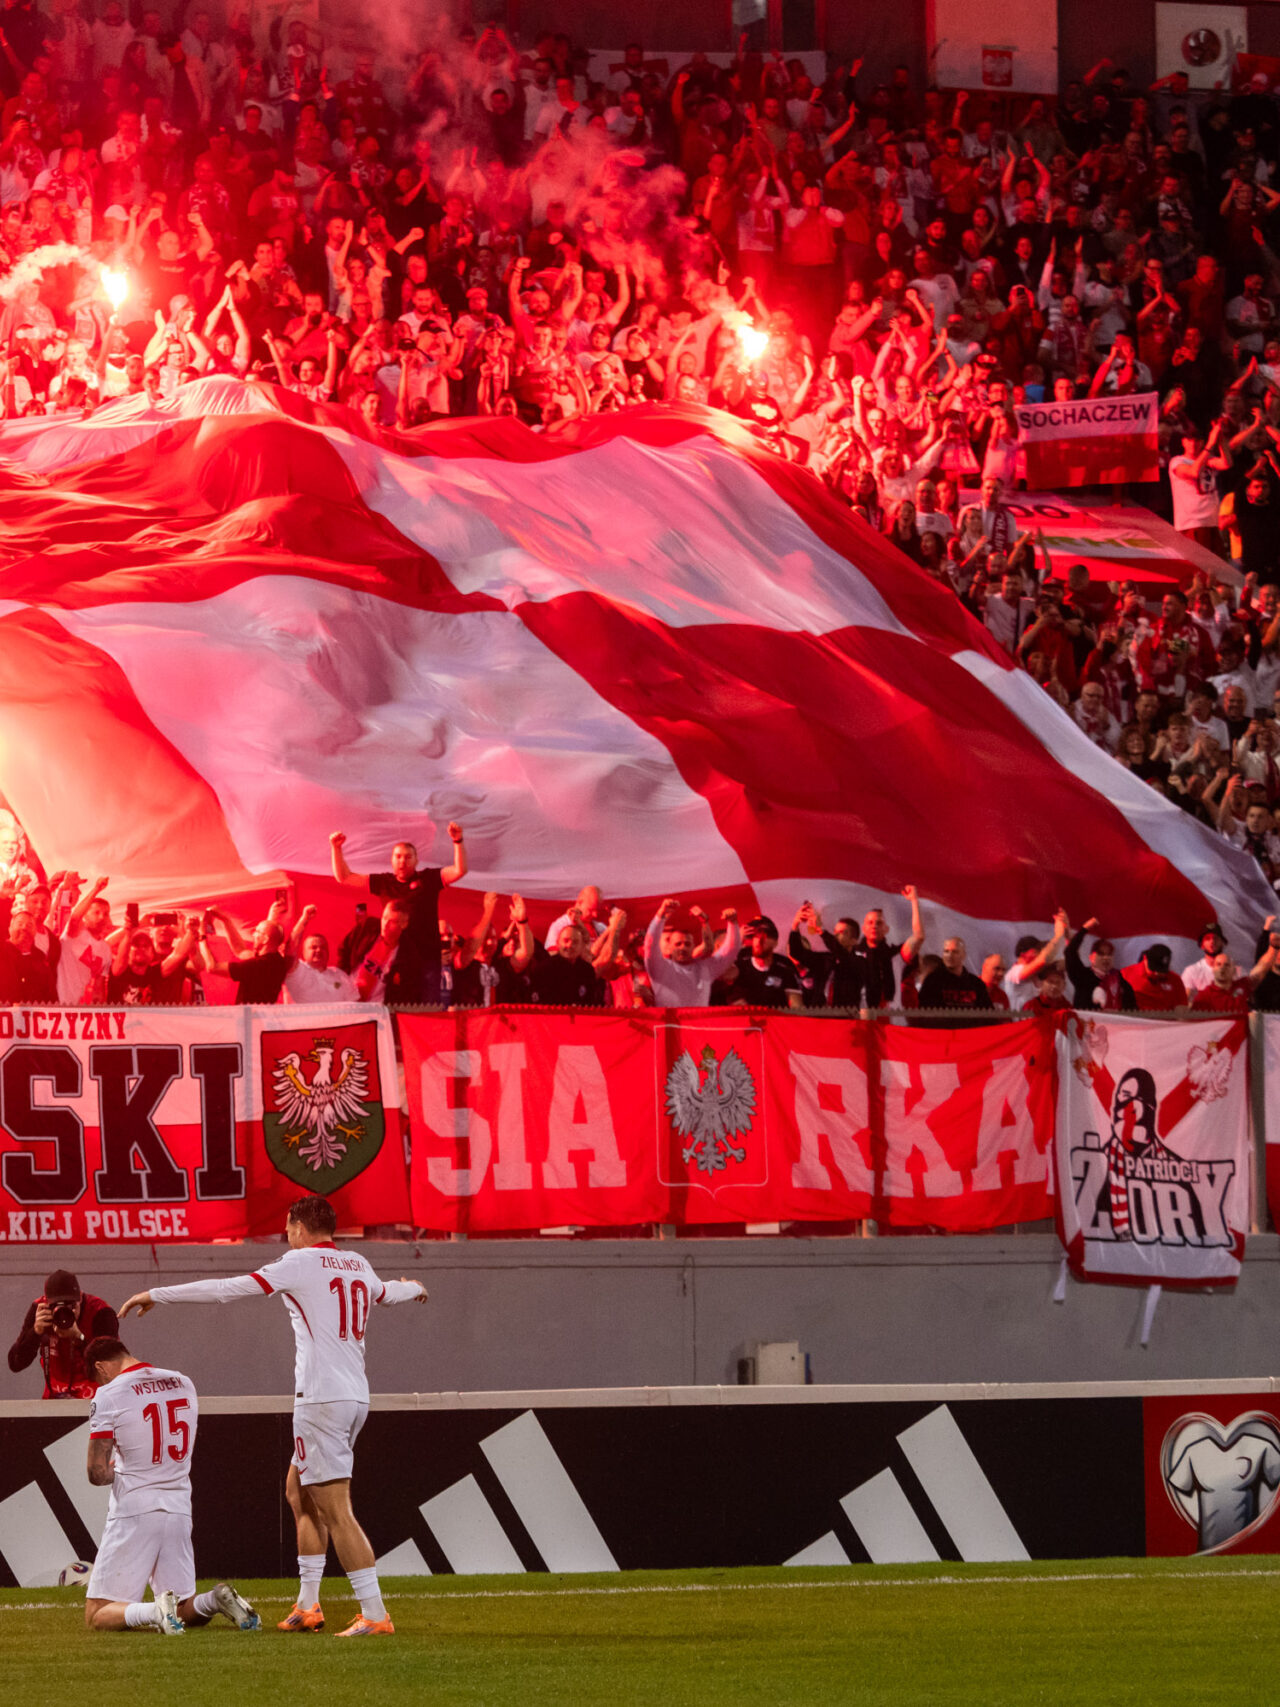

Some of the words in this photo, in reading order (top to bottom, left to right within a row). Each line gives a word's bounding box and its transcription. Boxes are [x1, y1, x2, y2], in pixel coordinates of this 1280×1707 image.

[1020, 403, 1151, 429] SOCHACZEW
[1124, 1154, 1200, 1184] PATRIOCI
[1071, 1131, 1236, 1247] ŻORY
[84, 1209, 189, 1238] POLSCE
[320, 1256, 366, 1272] ZIELIŃSKI
[329, 1277, 369, 1341] 10
[131, 1377, 184, 1395] WSZOŁEK
[143, 1398, 190, 1464] 15
